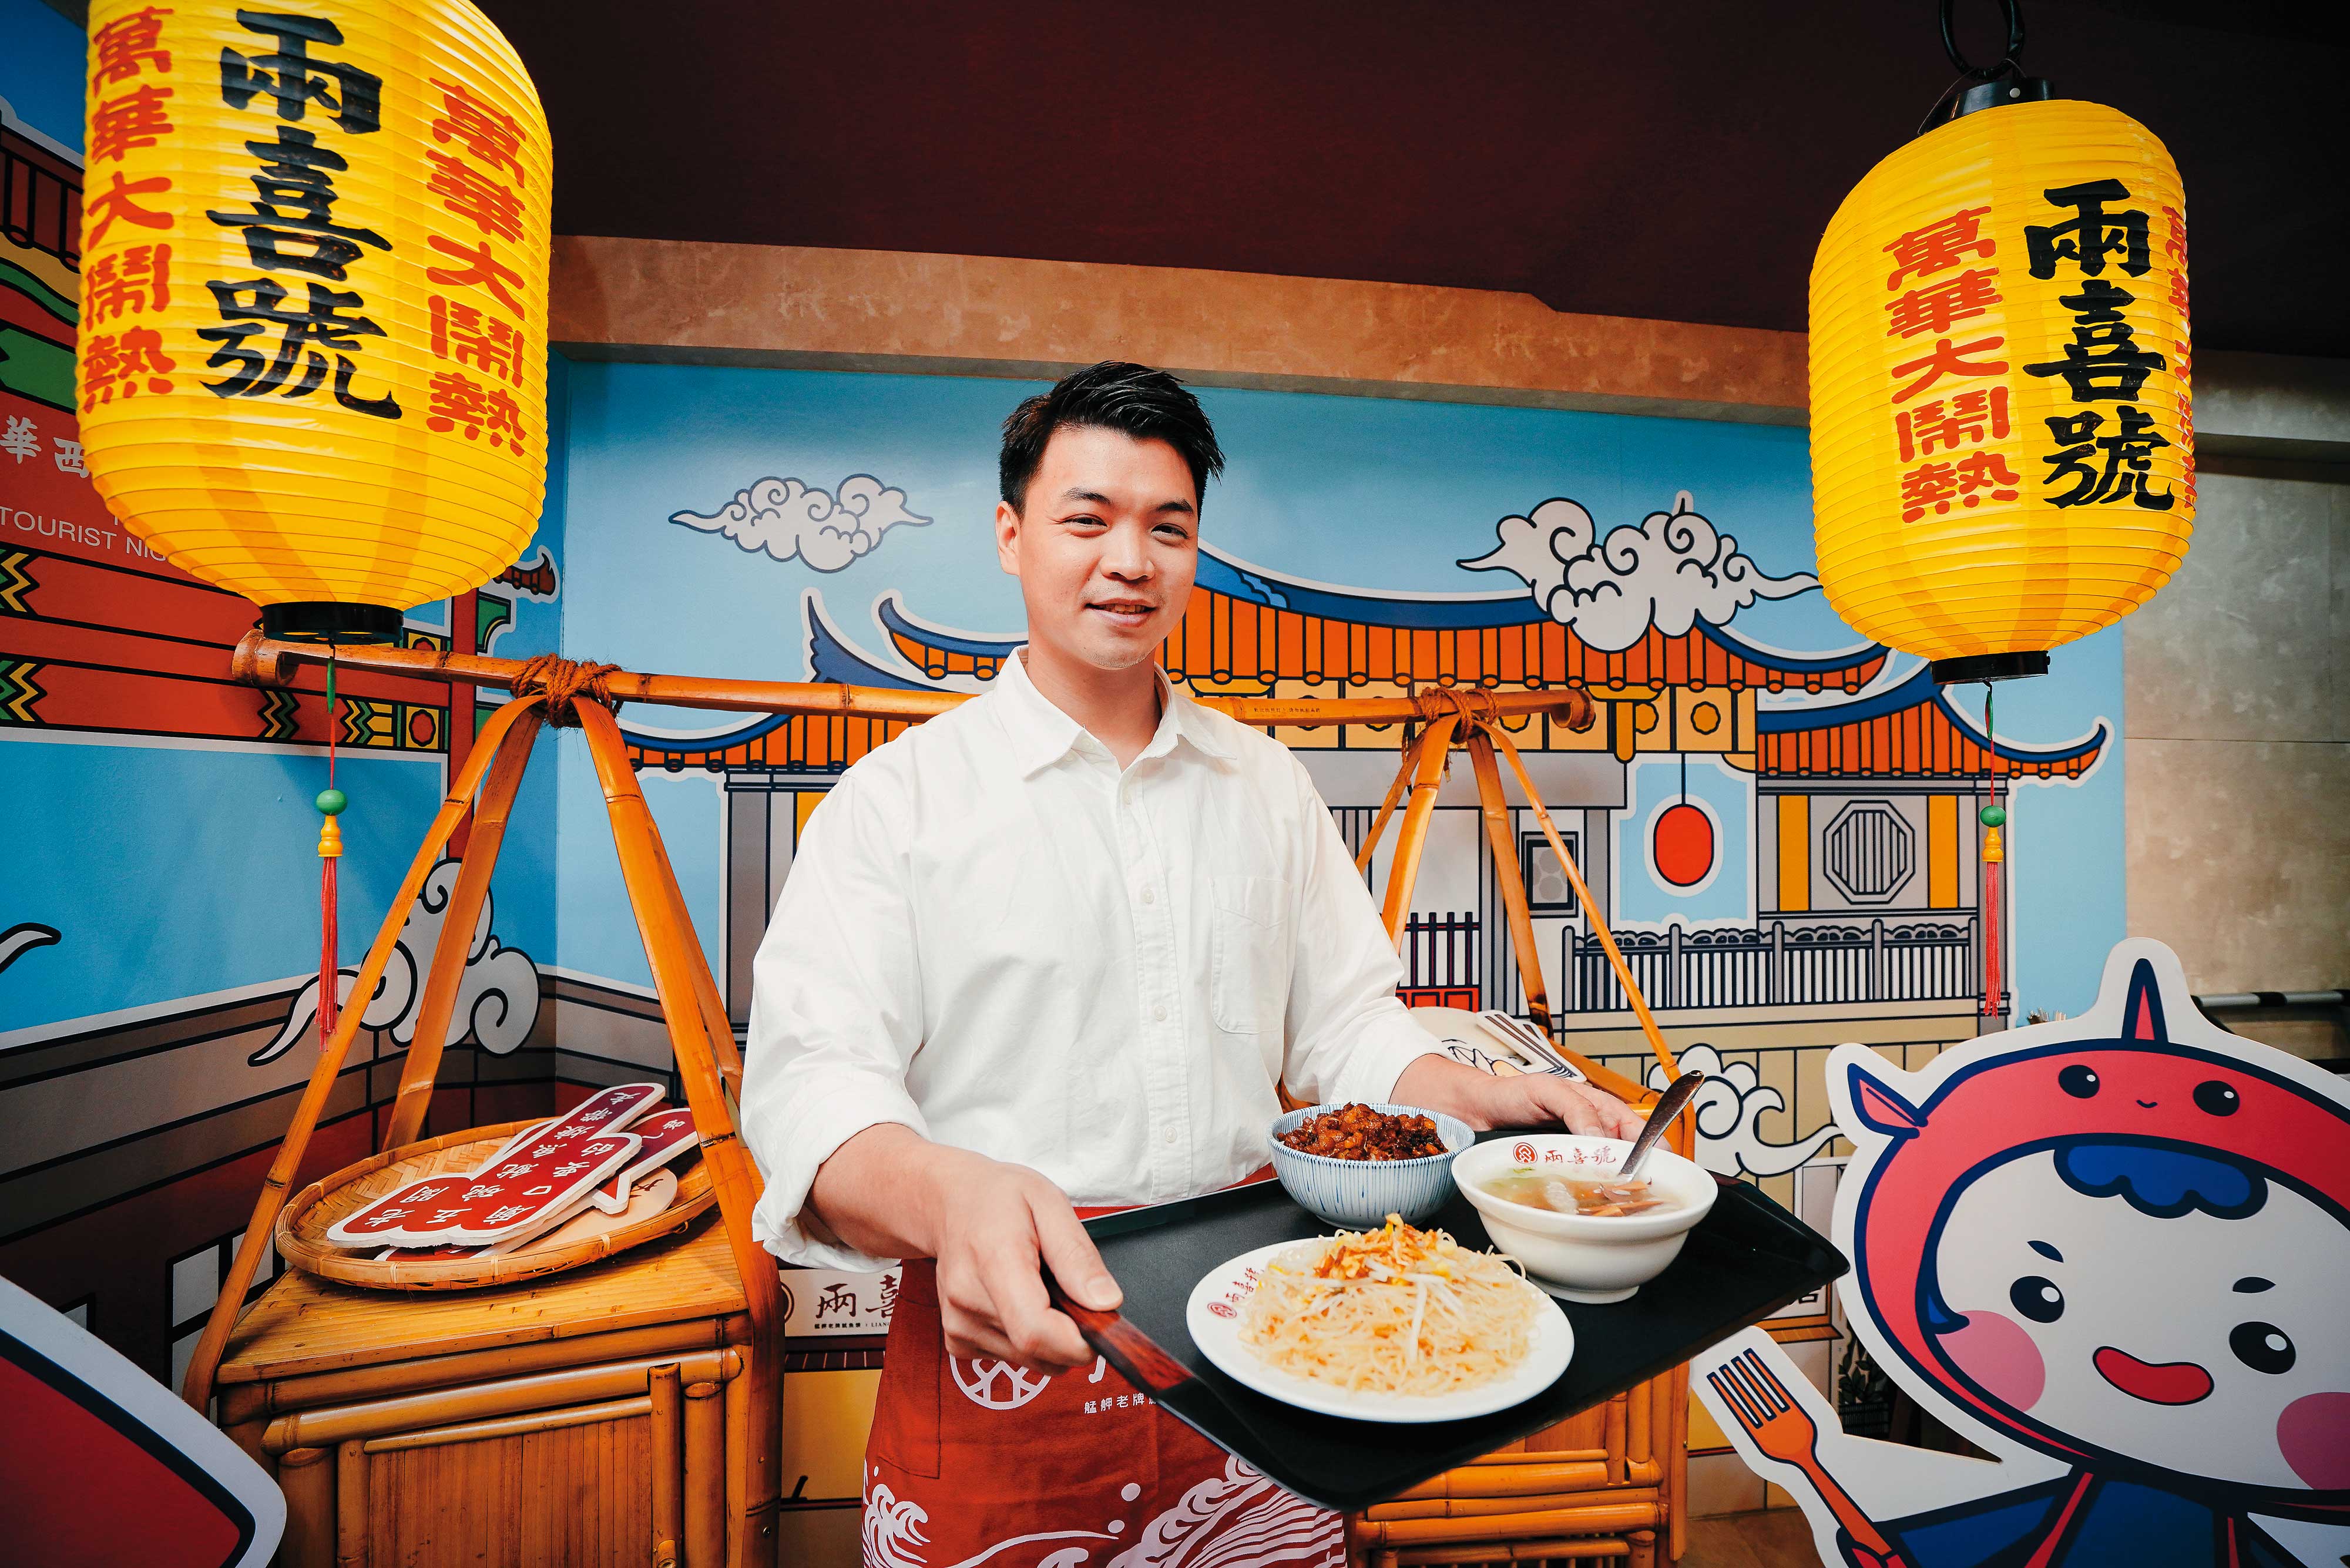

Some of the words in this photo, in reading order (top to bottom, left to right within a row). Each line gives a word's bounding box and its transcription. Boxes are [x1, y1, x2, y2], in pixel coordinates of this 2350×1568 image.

[83, 6, 176, 414] 萬華大鬧熱
[197, 8, 402, 419] 兩喜號
[426, 77, 526, 457] 萬華大鬧熱
[1882, 206, 2020, 524] 萬華大鬧熱
[2022, 178, 2175, 511] 兩喜號
[0, 506, 117, 549] TOURIST
[364, 1186, 450, 1227] 老闆
